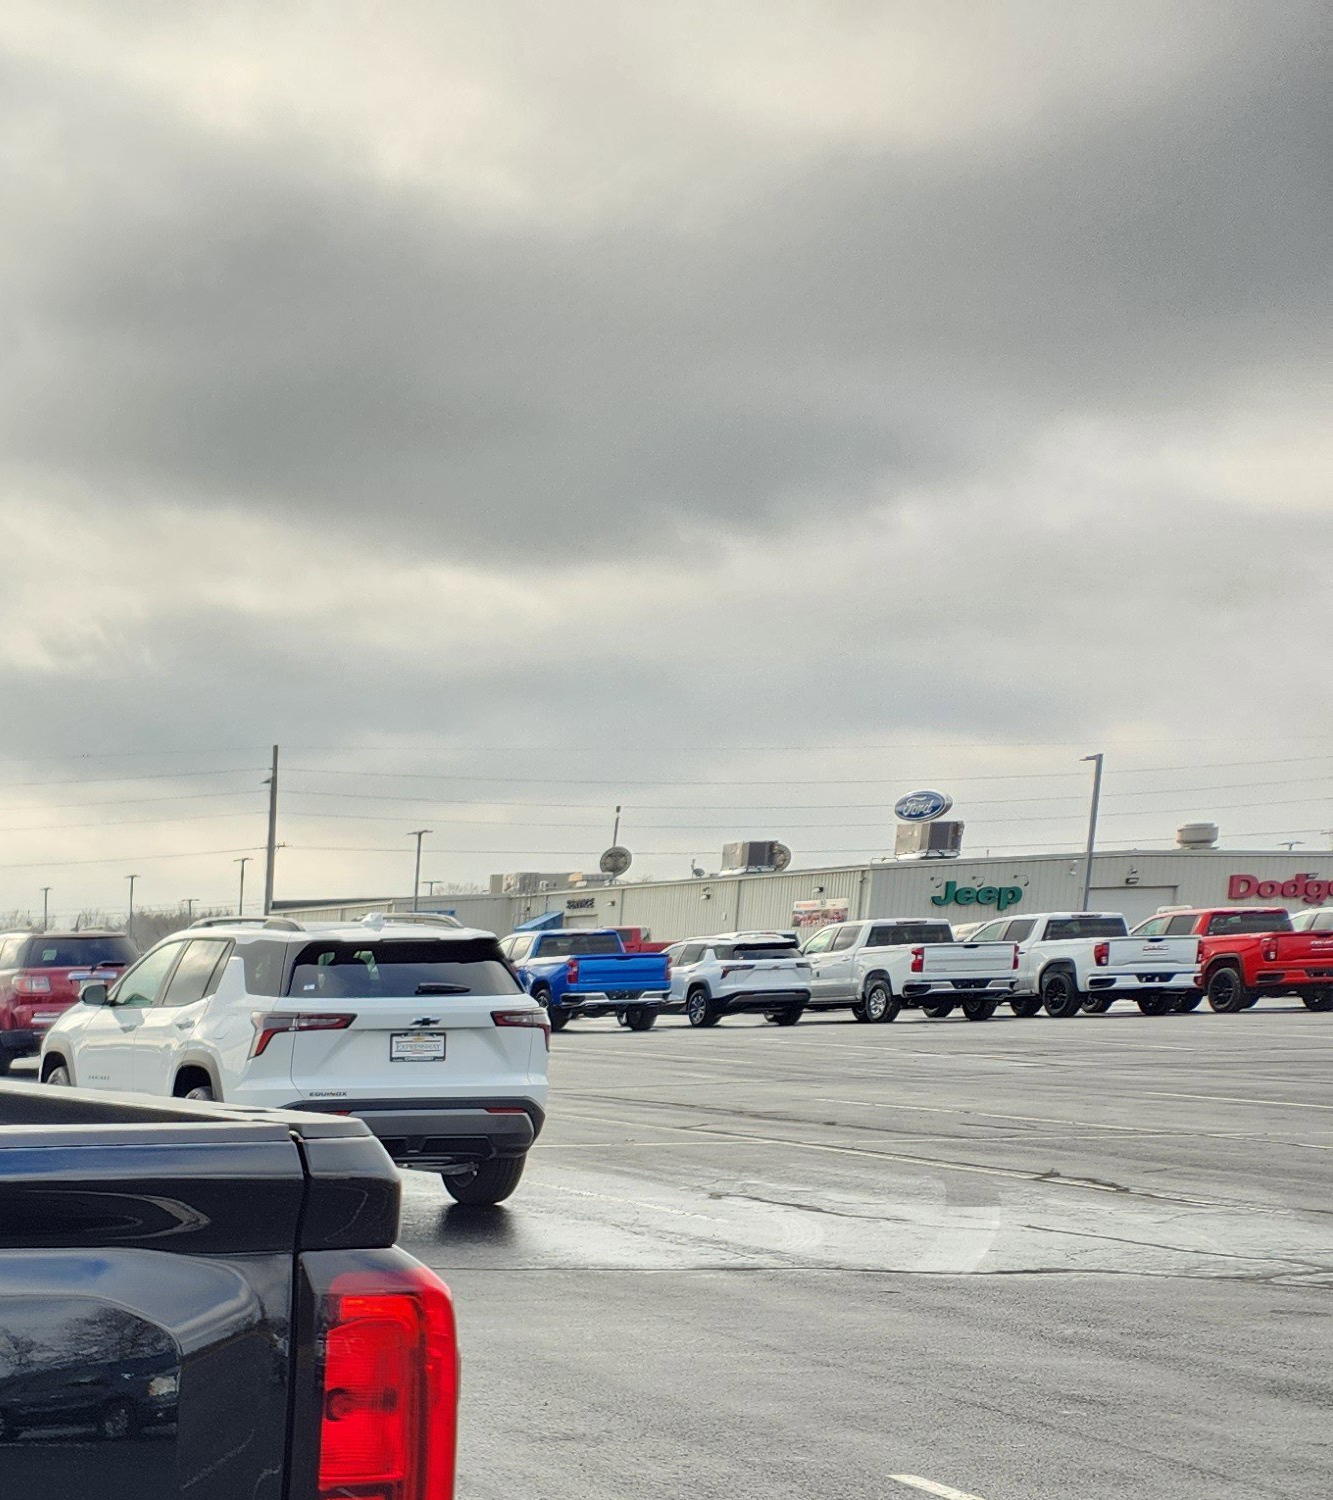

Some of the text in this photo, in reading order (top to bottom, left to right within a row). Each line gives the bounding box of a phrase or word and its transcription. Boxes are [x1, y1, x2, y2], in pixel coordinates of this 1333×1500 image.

[902, 795, 935, 816] Ford
[930, 880, 1023, 911] Jeep
[1227, 872, 1333, 906] Dodg
